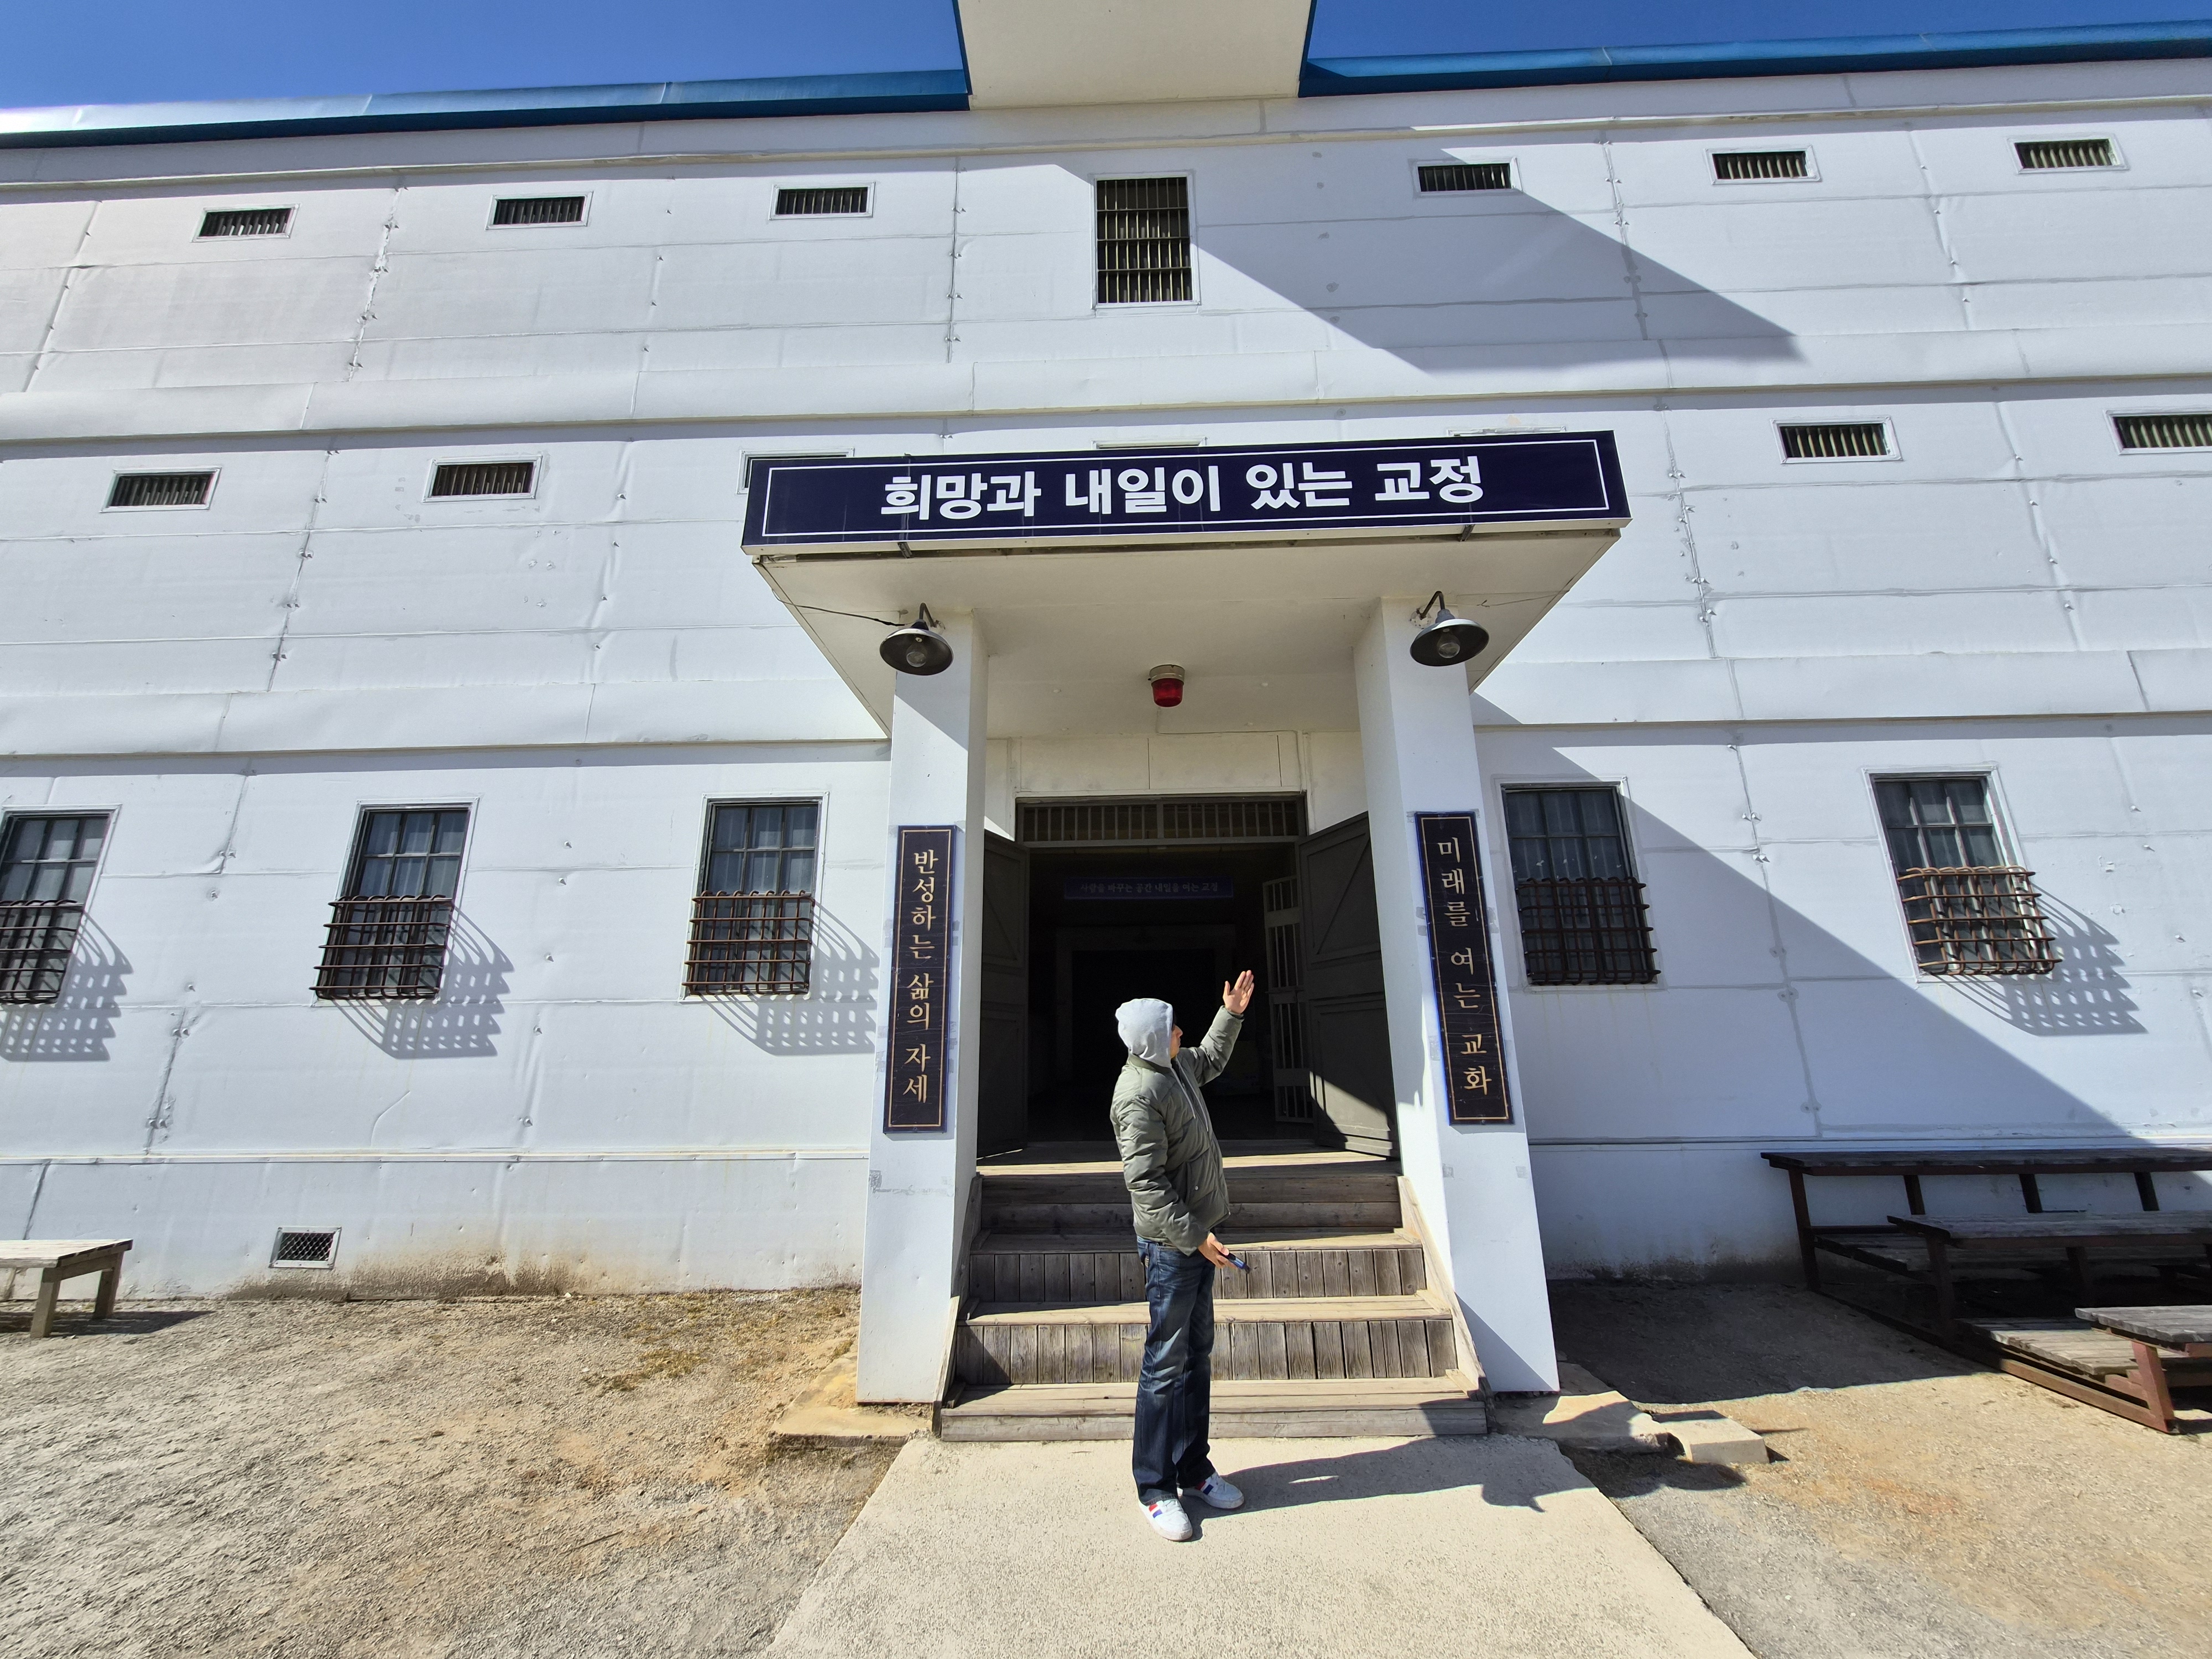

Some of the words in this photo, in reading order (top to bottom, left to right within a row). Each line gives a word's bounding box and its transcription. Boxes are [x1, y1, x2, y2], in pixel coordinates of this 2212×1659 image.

[881, 474, 1041, 520] 희망과
[1065, 466, 1220, 514] 내일이
[1246, 462, 1352, 510] 있는
[1375, 456, 1483, 503] 교정
[909, 849, 938, 959] 반성하는
[1108, 883, 1133, 893] 바꾸는
[1155, 882, 1180, 893] 내일을
[1182, 882, 1199, 893] 여는
[1437, 837, 1471, 927] 미래를
[907, 973, 934, 1030] 삶의
[1451, 947, 1481, 1009] 여는
[902, 1044, 931, 1103] 자세
[1460, 1034, 1492, 1095] 교화
